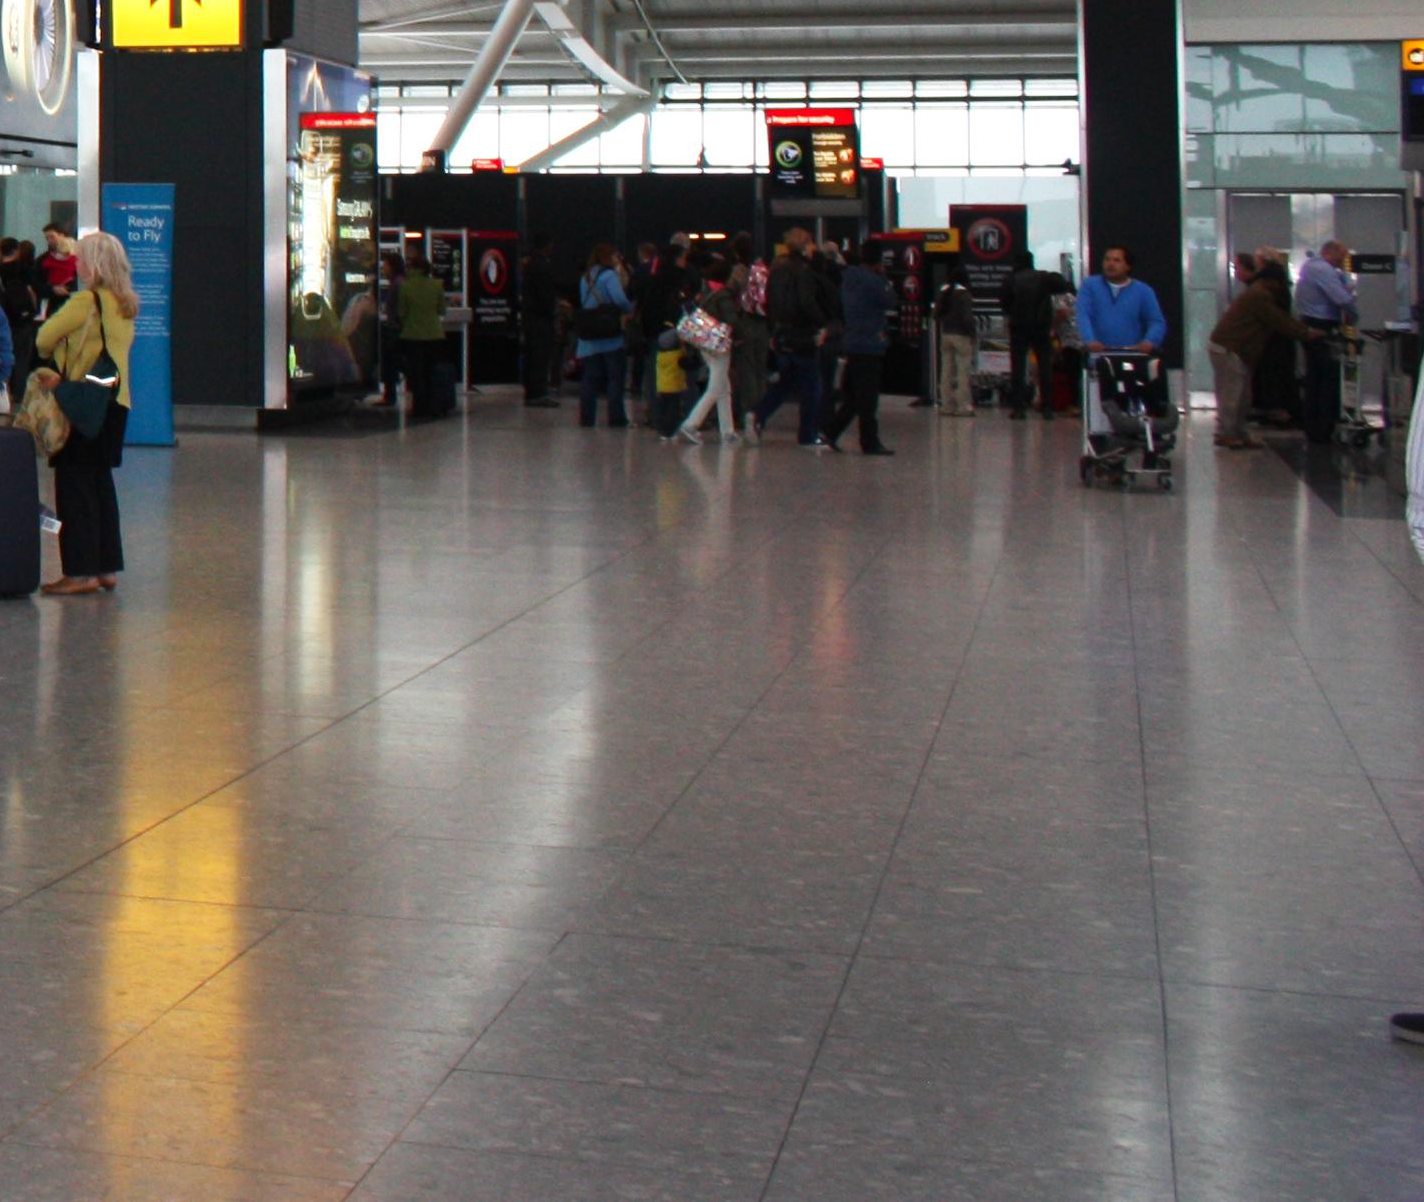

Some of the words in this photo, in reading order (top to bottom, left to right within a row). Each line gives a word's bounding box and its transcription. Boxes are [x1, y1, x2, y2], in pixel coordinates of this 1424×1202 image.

[128, 214, 165, 230] Ready
[128, 231, 141, 242] to
[144, 229, 162, 244] Fly
